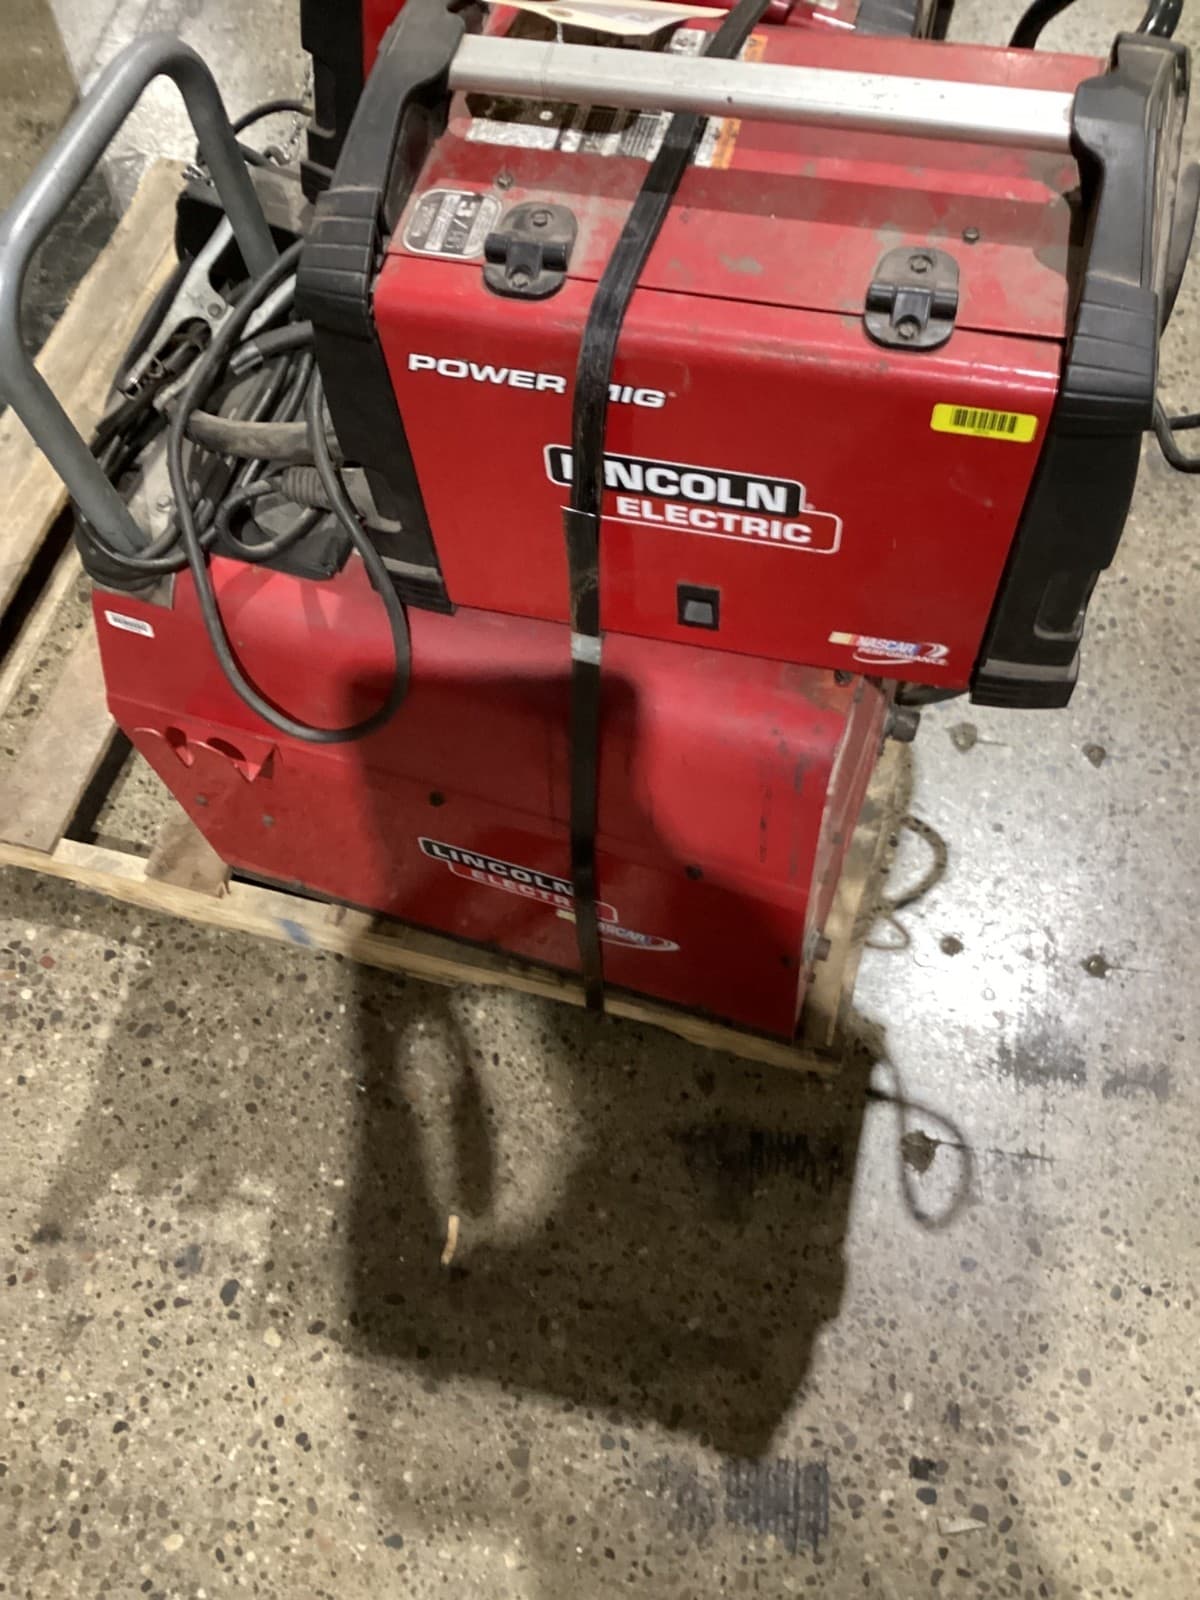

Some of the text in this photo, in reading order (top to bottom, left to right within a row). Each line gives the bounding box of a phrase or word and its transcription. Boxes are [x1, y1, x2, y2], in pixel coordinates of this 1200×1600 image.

[407, 353, 666, 408] POWER IG
[615, 495, 812, 544] ELECTRIC
[858, 635, 917, 655] NASCAR
[470, 865, 571, 907] ELECTR
